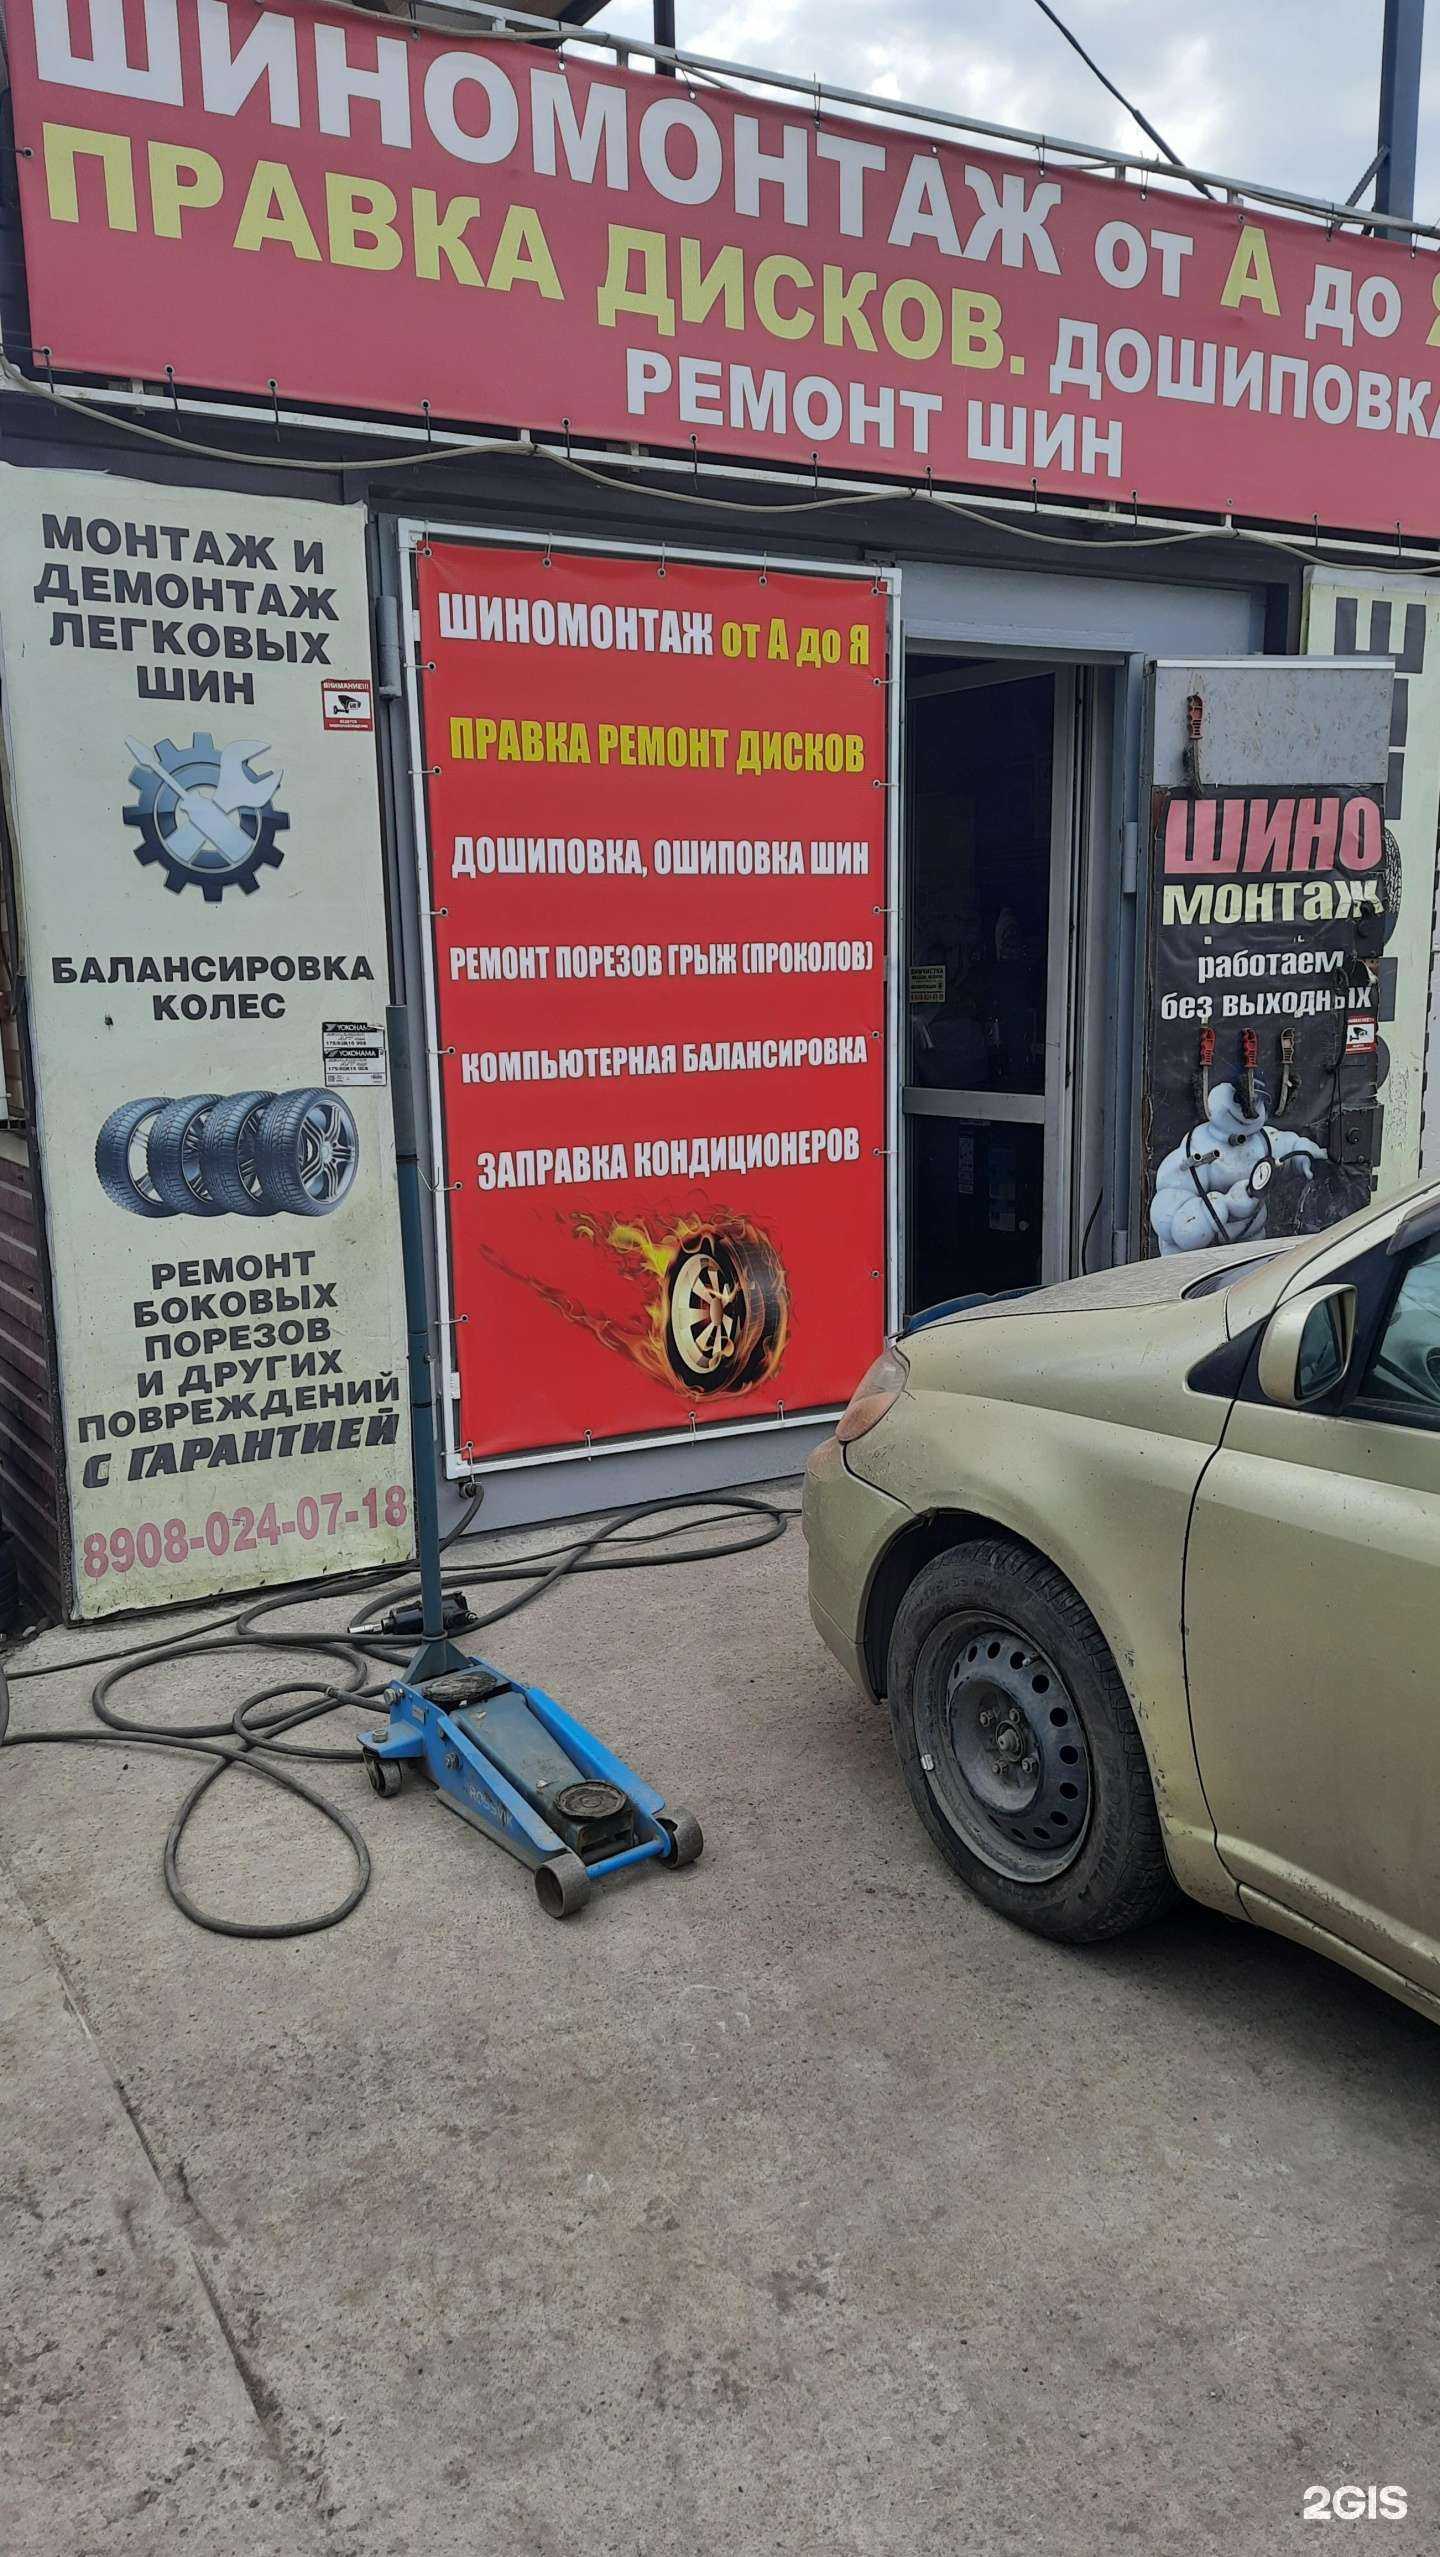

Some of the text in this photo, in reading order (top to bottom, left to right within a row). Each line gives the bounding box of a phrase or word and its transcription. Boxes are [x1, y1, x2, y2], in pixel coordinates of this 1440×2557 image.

[33, 0, 1062, 276] ШИНОМОНТАЖ
[1093, 220, 1193, 298] от
[1220, 225, 1282, 317] А
[1304, 263, 1402, 347] до
[42, 121, 566, 301] ПРАВКА
[596, 223, 1025, 376] ДИСКОВ.
[625, 347, 1123, 478] РЕМОНТ ШИН
[41, 512, 325, 575] МОНТАЖ И
[33, 562, 340, 621] ДЕМОНТАЖ
[49, 611, 332, 666] ЛЕГКОВЫХ
[438, 591, 871, 669] ШИНОМОНТАЖ от А до Я
[136, 664, 256, 706] ШИН
[449, 716, 865, 776] ПРАВКА РЕМОНТ ДИСКОВ
[451, 835, 870, 879] ДОШИПОВКА, ОШИПОВКА ШИН
[1163, 796, 1383, 875] ШИНО
[51, 955, 375, 985] БАЛАНСИРОВКА
[449, 940, 874, 981] РЕМОНТ ПОРЕЗОВ ГРЫЖ (ПРОКОЛОВ)
[1198, 950, 1345, 984] работаем
[152, 992, 287, 1021] КОЛЕС
[1161, 986, 1372, 1021] без выходных
[461, 1035, 868, 1085] КОМПЬЮТЕРНАЯ БАЛАНСИРОВКА
[476, 1126, 860, 1192] ЗАПРАВКА КОНДИЦИОНЕРОВ
[151, 1249, 316, 1291] РЕМОНТ
[133, 1281, 339, 1328] БОКОВЫХ
[144, 1317, 332, 1362] ПОРЕЗОВ
[136, 1348, 343, 1400] И ДРУГИХ
[78, 1371, 400, 1444] ПОВРЕЖДЕНИЙ
[82, 1407, 401, 1489] С ГАРАНТИЕЙ
[83, 1484, 408, 1579] 8908-024-07-18
